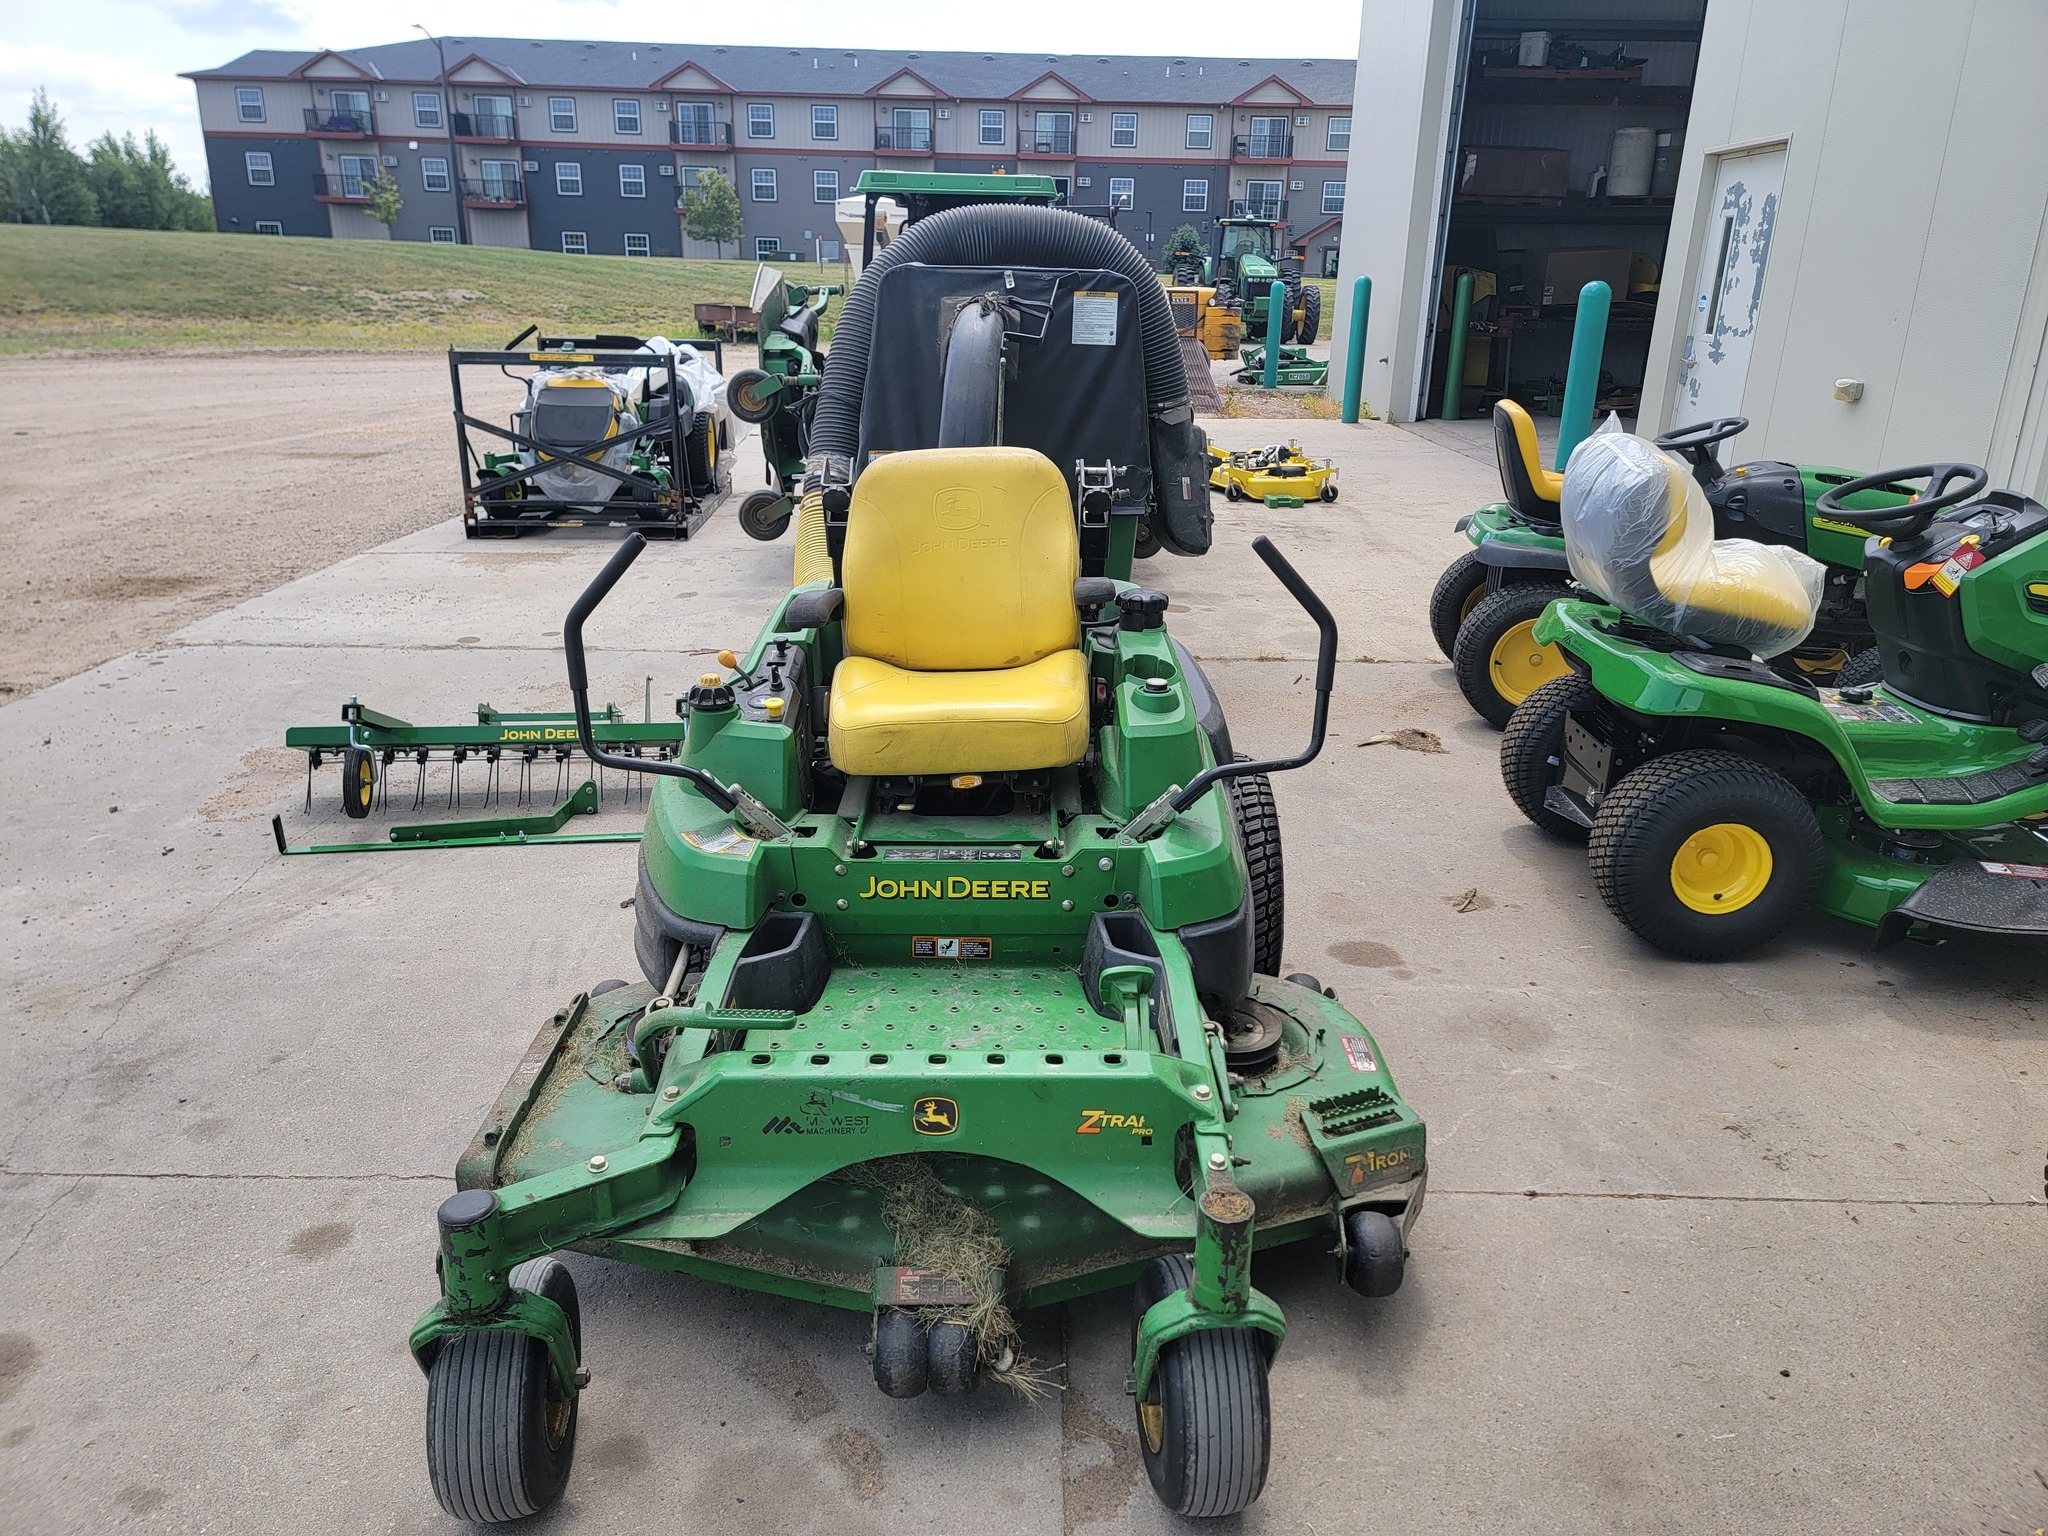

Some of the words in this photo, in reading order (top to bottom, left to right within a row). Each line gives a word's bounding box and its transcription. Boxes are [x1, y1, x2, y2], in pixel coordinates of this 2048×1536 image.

[912, 540, 954, 555] JOHN
[958, 538, 1008, 552] DEERE
[500, 729, 541, 740] JOHN
[545, 728, 595, 739] DEE
[859, 876, 941, 899] JOHN
[947, 876, 1050, 899] DEERE
[806, 1127, 855, 1135] MACHINERY
